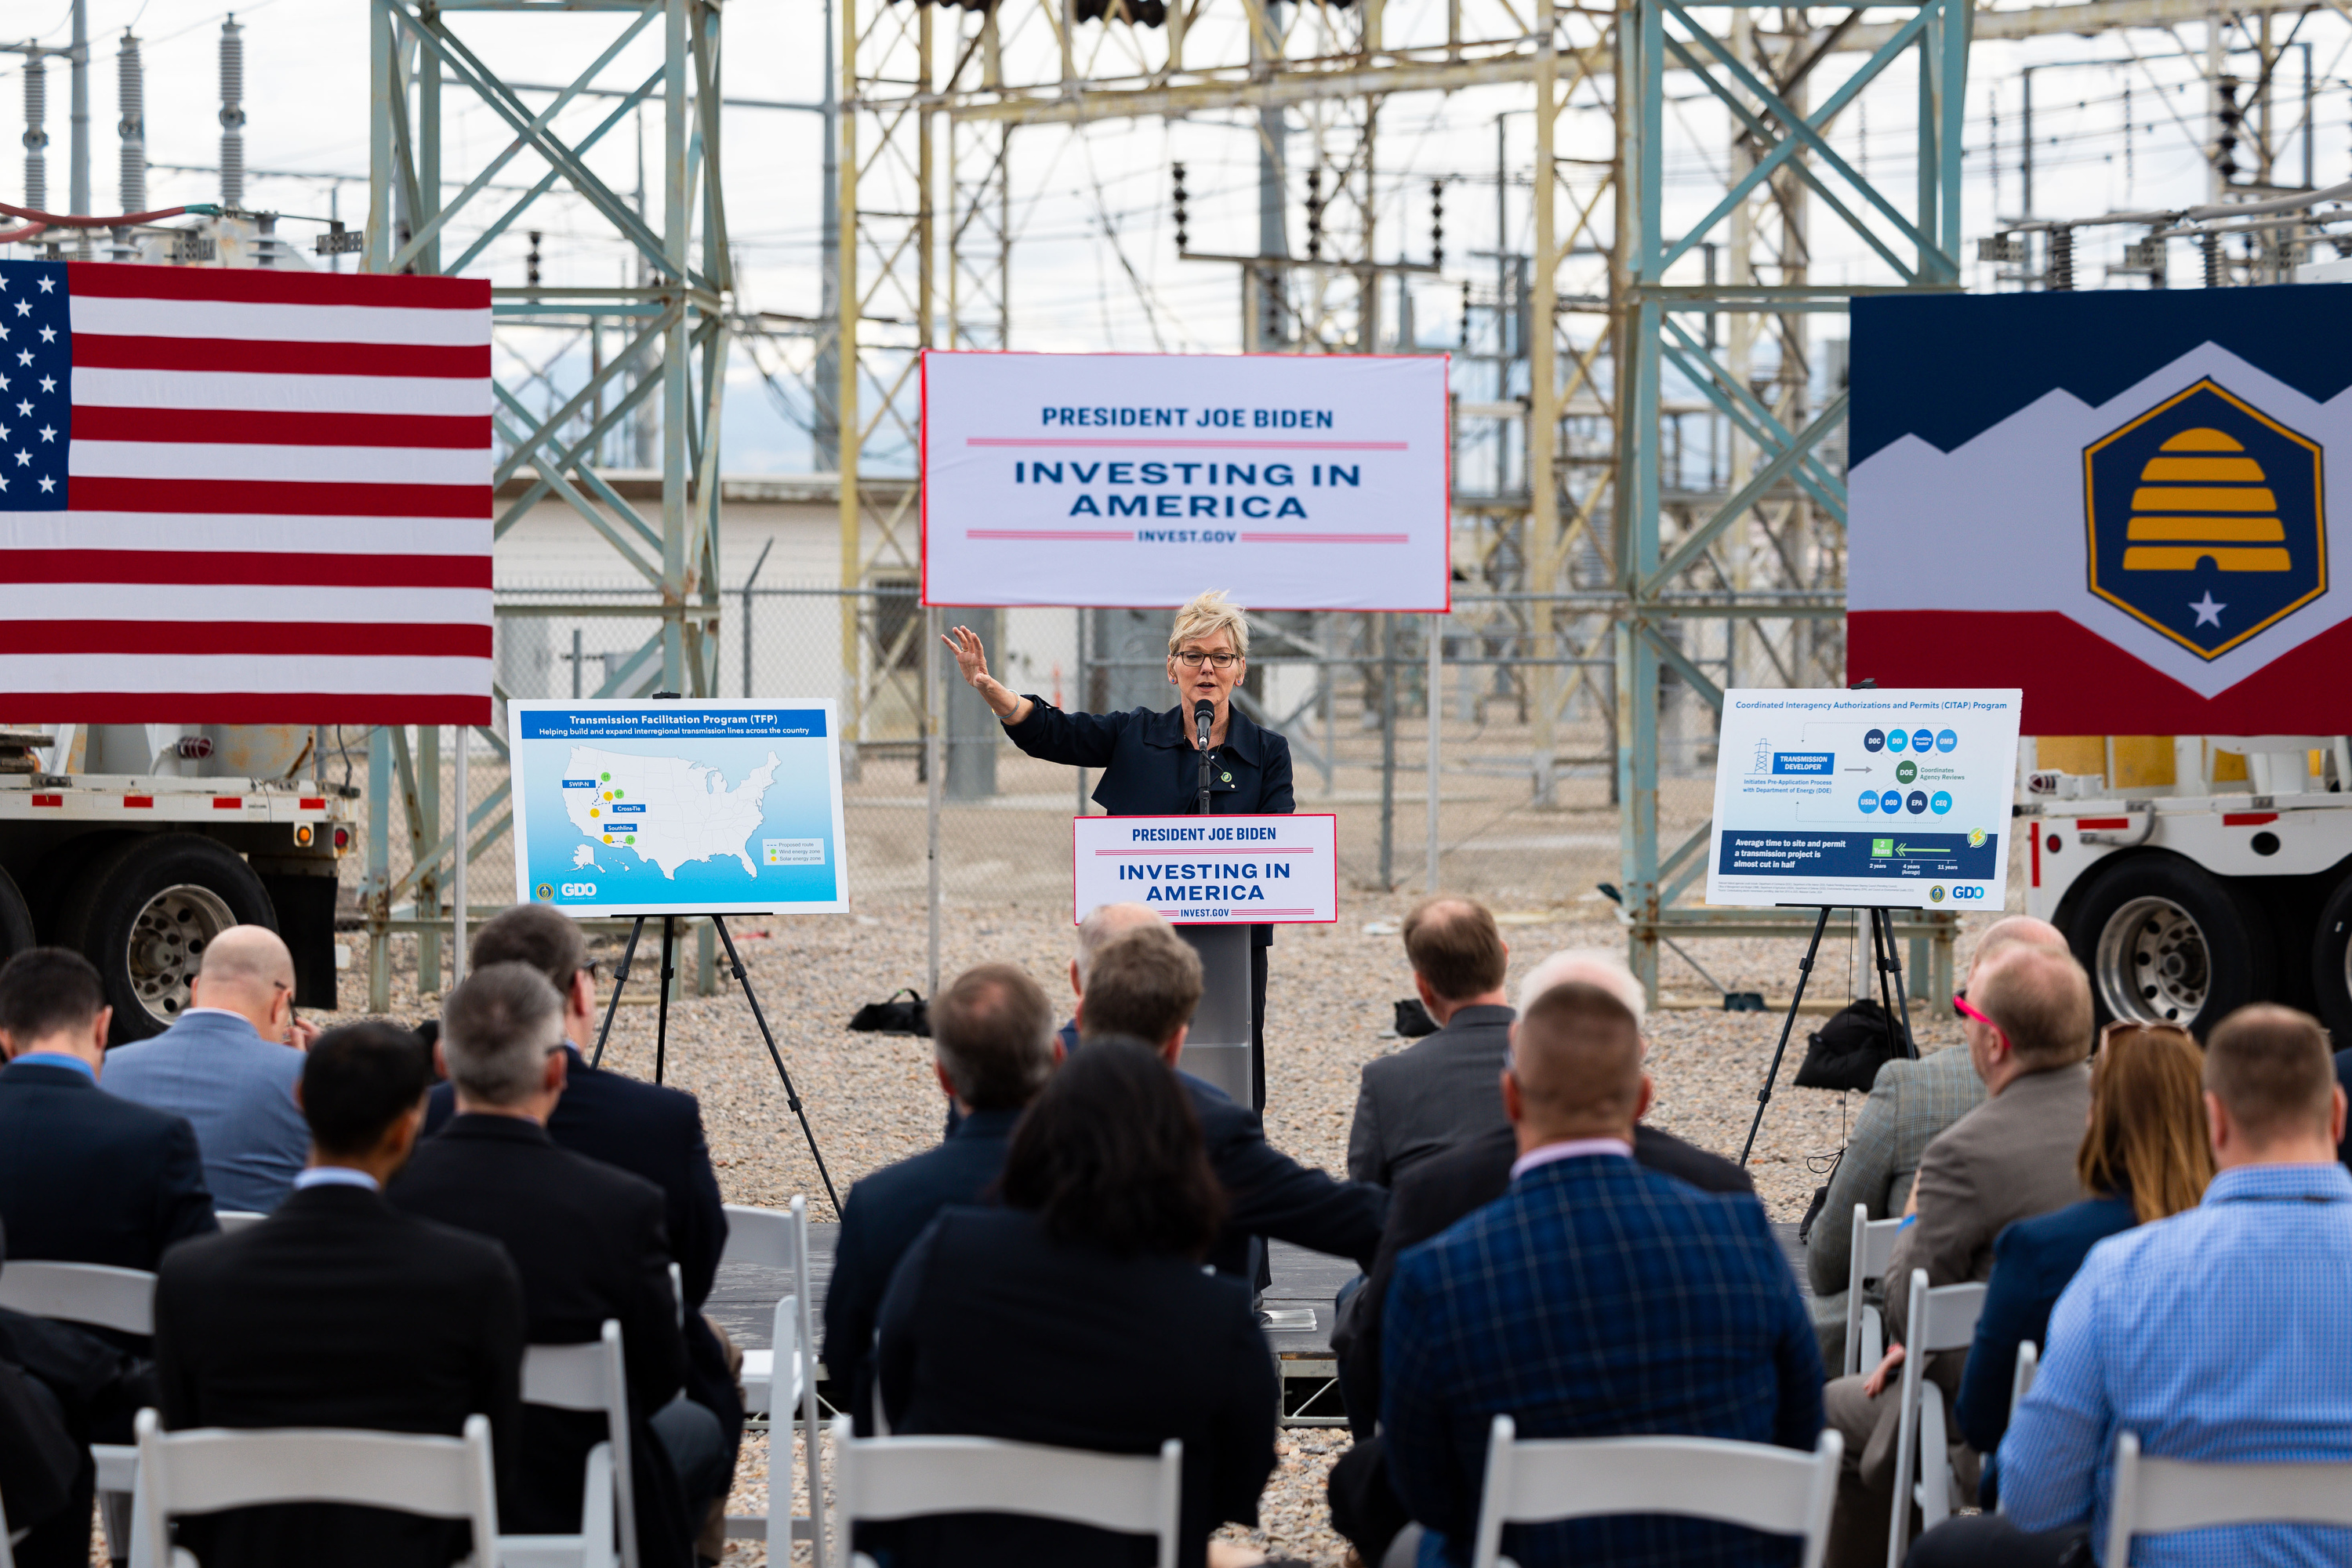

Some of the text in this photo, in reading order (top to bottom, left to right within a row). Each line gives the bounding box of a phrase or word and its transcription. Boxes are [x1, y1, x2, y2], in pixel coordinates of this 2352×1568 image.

[1042, 408, 1334, 429] PRESIDENT JOE BIDEN
[1015, 461, 1360, 486] INVESTING IN
[1069, 494, 1308, 518] AMERICA
[1138, 530, 1236, 543] INVEST.GOV
[1786, 702, 1831, 710] Interagency
[1941, 701, 1971, 710] (CITAP)
[1973, 702, 2007, 710] Program
[641, 715, 700, 724] Facilitation
[703, 715, 747, 726] Program
[750, 715, 778, 724] (TFP)
[605, 728, 633, 736] expand
[1132, 827, 1276, 841] PRESIDENT JOE BIDEN
[1735, 839, 1764, 848] Average
[1822, 840, 1846, 848] permit
[1788, 851, 1813, 859] project
[1120, 863, 1290, 880] INVESTING IN
[561, 883, 597, 896] GDO
[1146, 884, 1265, 901] AMERICA
[1952, 886, 1984, 899] GDO
